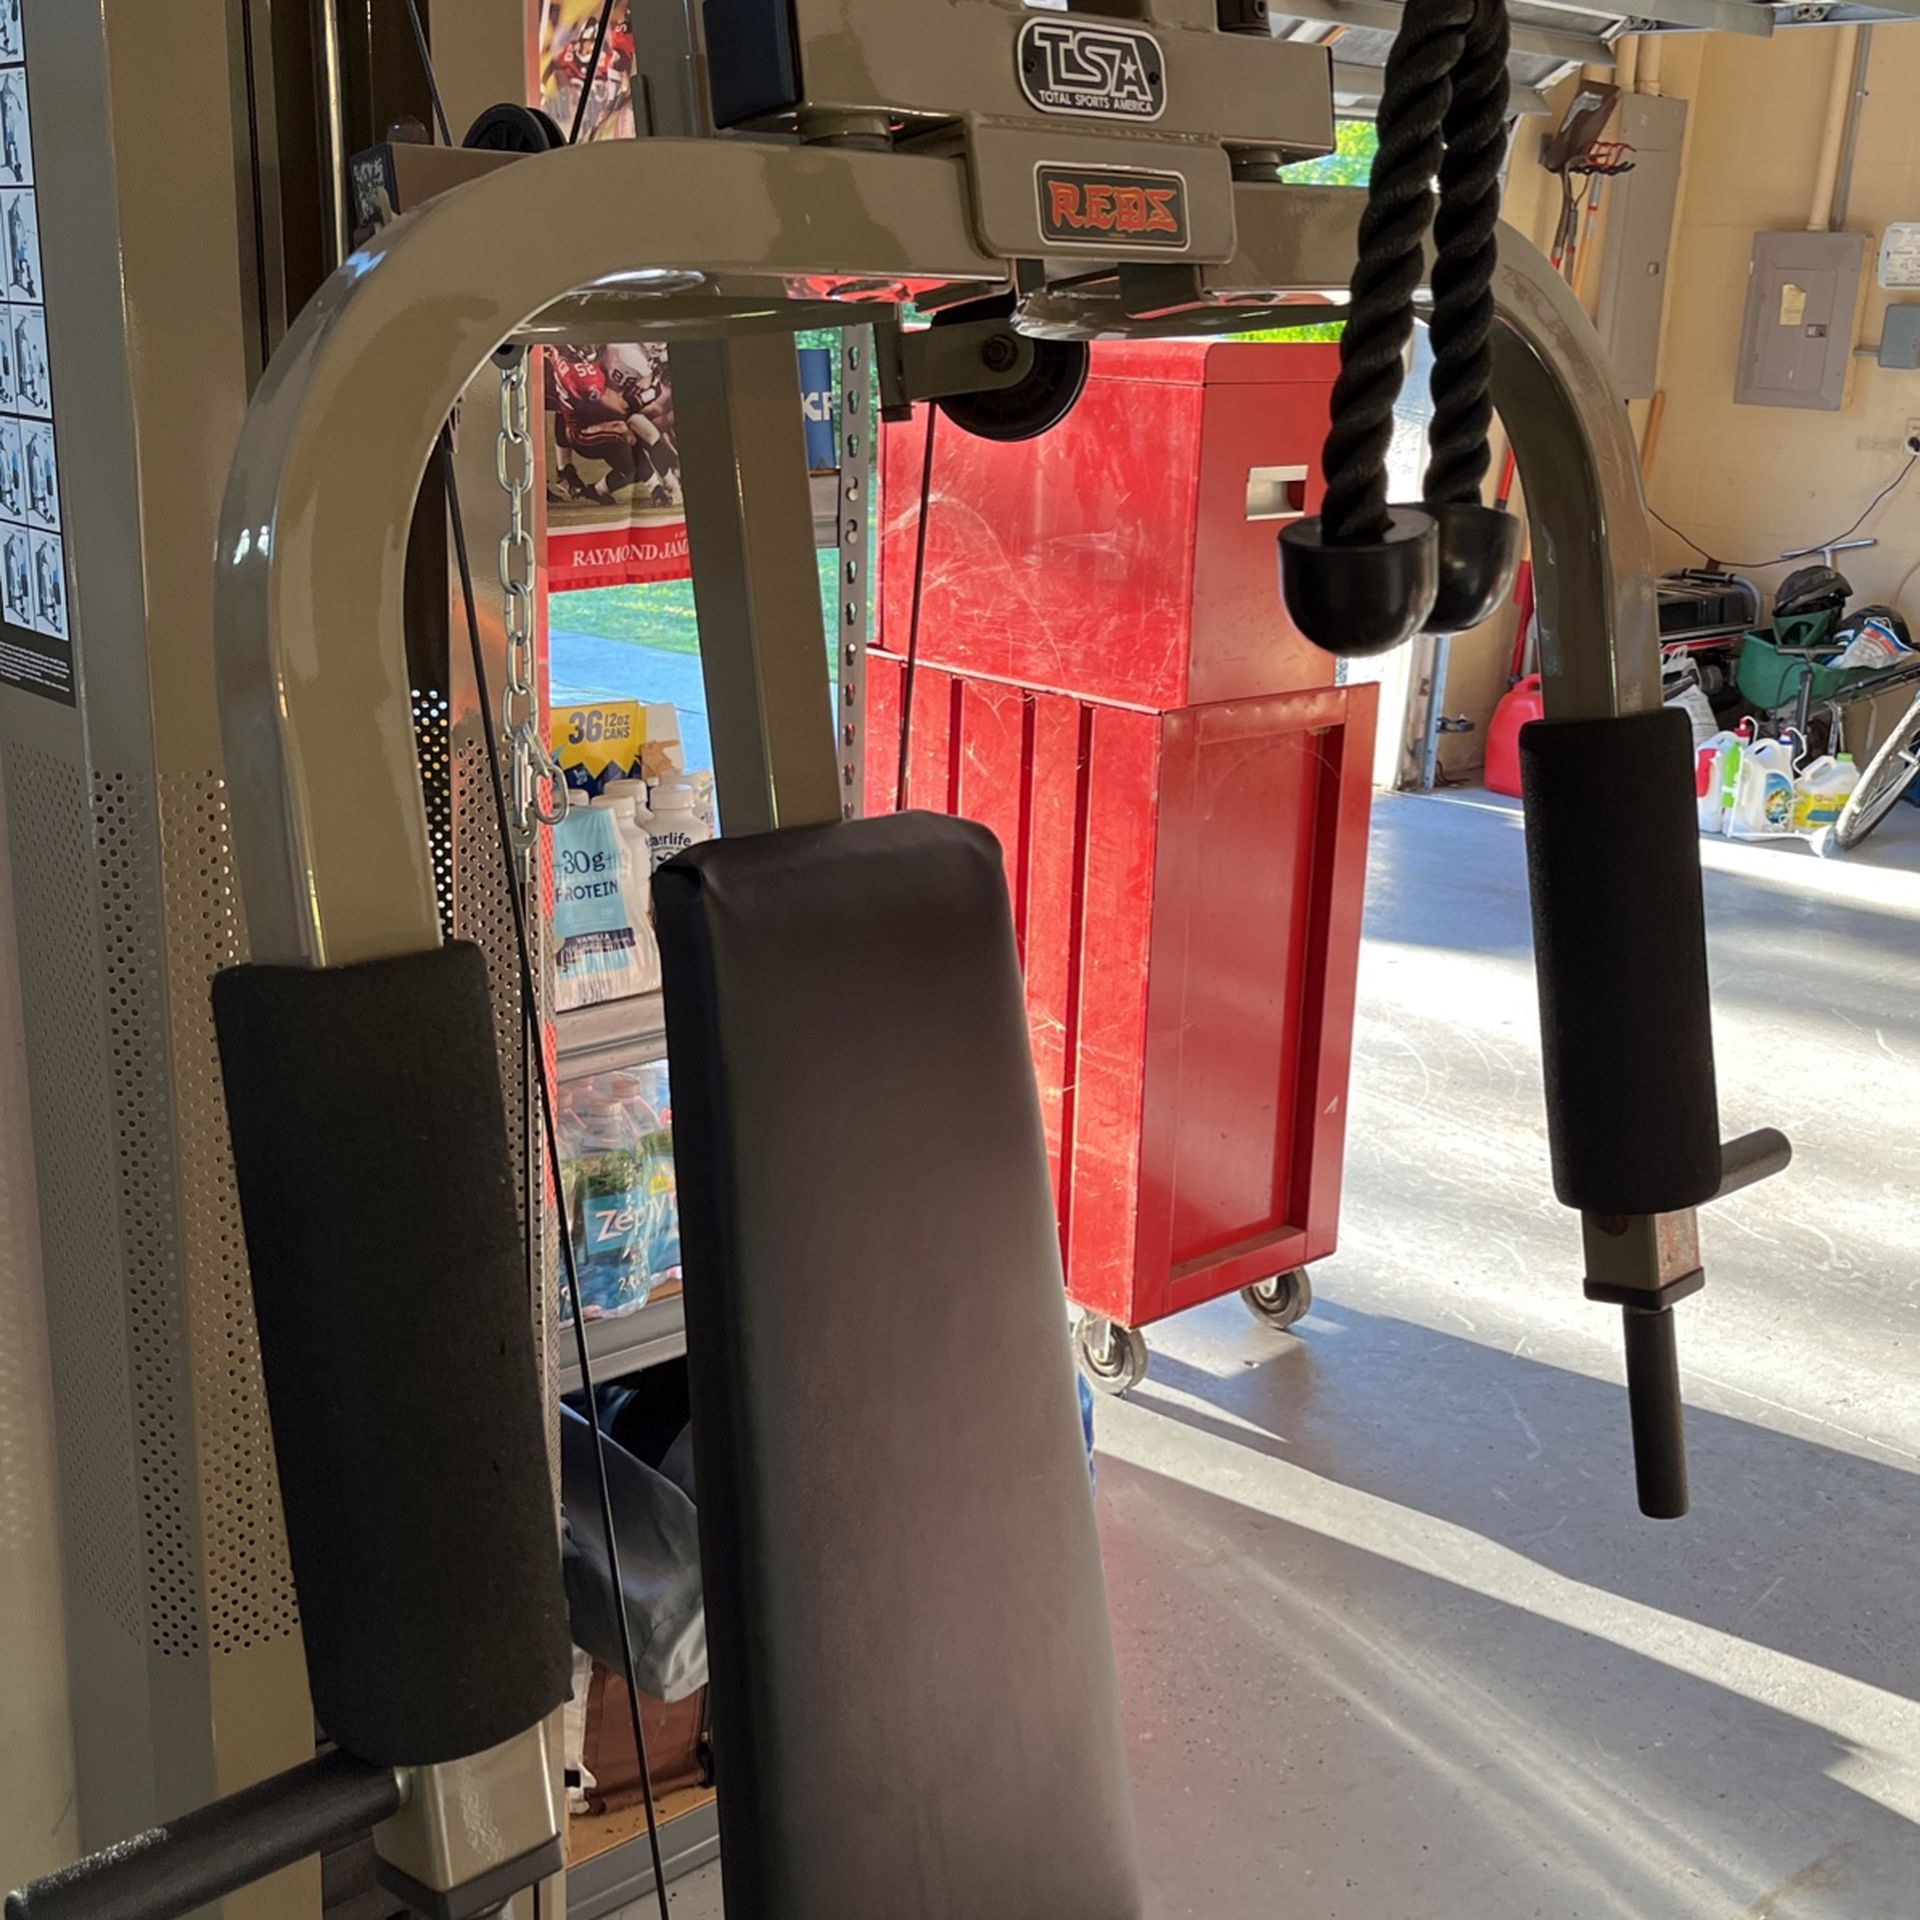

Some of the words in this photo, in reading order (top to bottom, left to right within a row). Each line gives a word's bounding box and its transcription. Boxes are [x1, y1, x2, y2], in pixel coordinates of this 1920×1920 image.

[1034, 26, 1153, 101] TSA
[1039, 89, 1072, 106] TOTAL
[1074, 94, 1111, 110] SPORTS
[1113, 98, 1154, 114] AMERICA
[572, 544, 659, 568] RAYMOND
[567, 709, 604, 745] 36
[603, 726, 631, 741] CANS
[562, 849, 606, 875] 30g
[555, 879, 618, 903] PROTEIN
